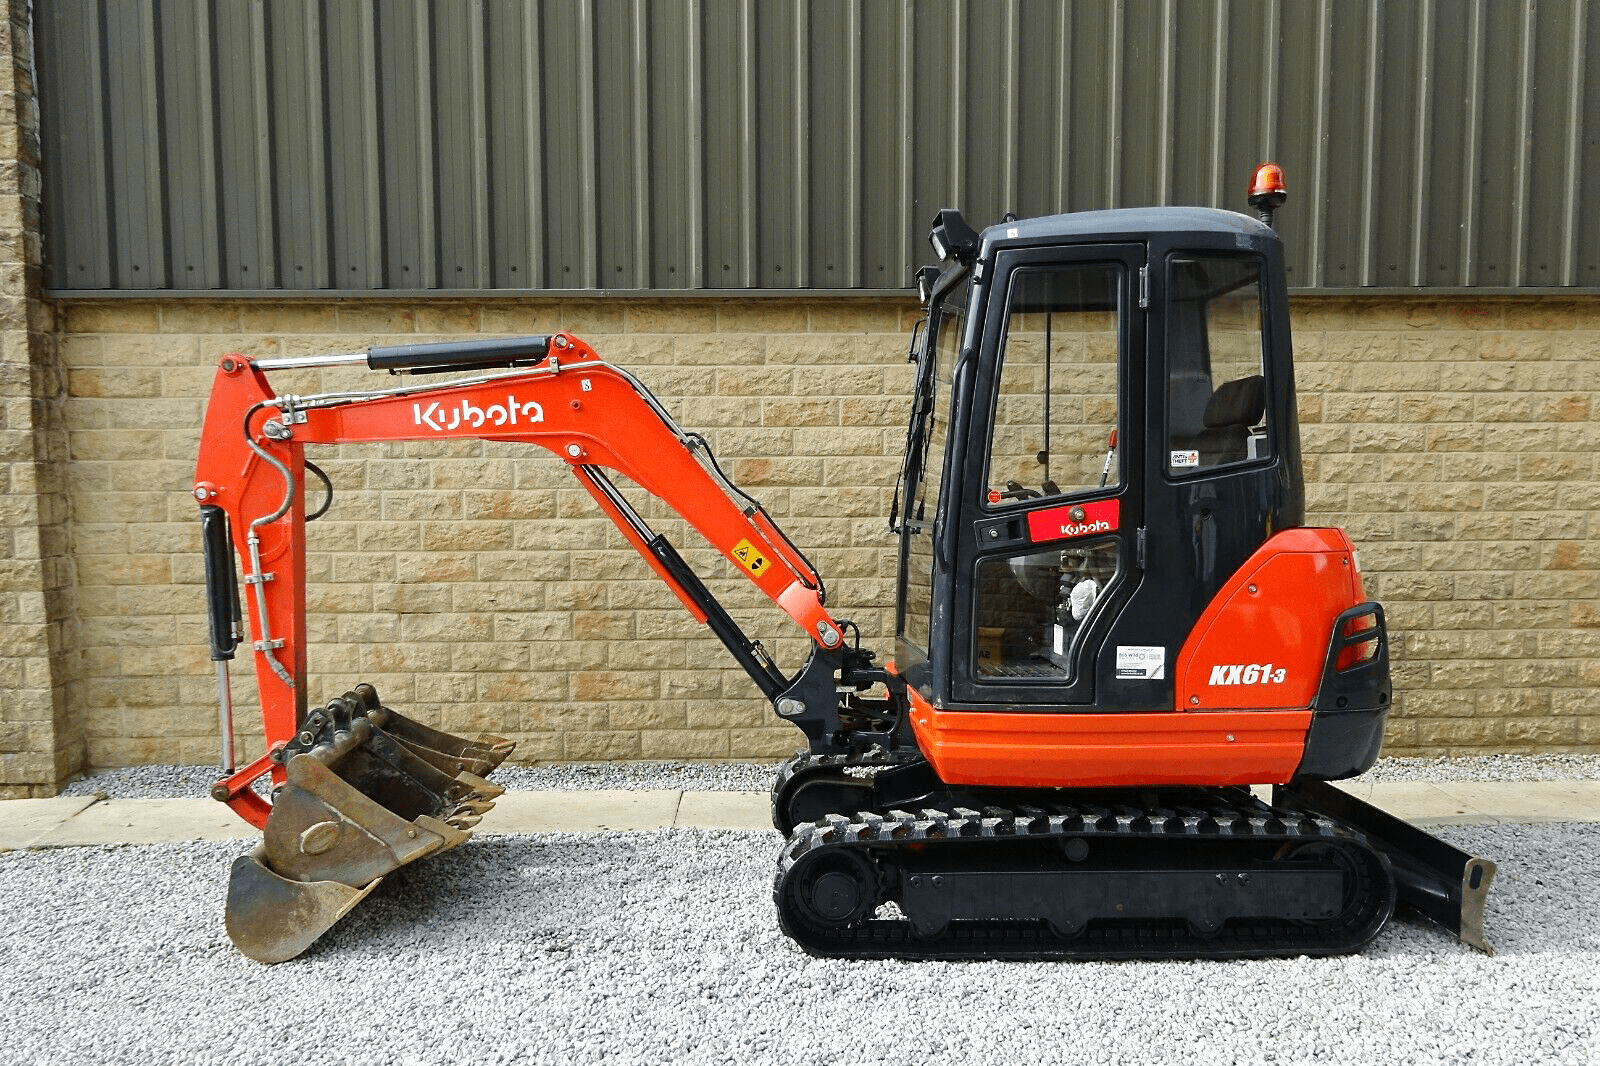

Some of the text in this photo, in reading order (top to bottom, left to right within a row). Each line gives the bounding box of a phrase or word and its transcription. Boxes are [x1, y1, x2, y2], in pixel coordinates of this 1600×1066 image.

[413, 395, 544, 431] Kubota
[1060, 519, 1109, 536] Kubota
[1208, 664, 1286, 685] KX61-3
